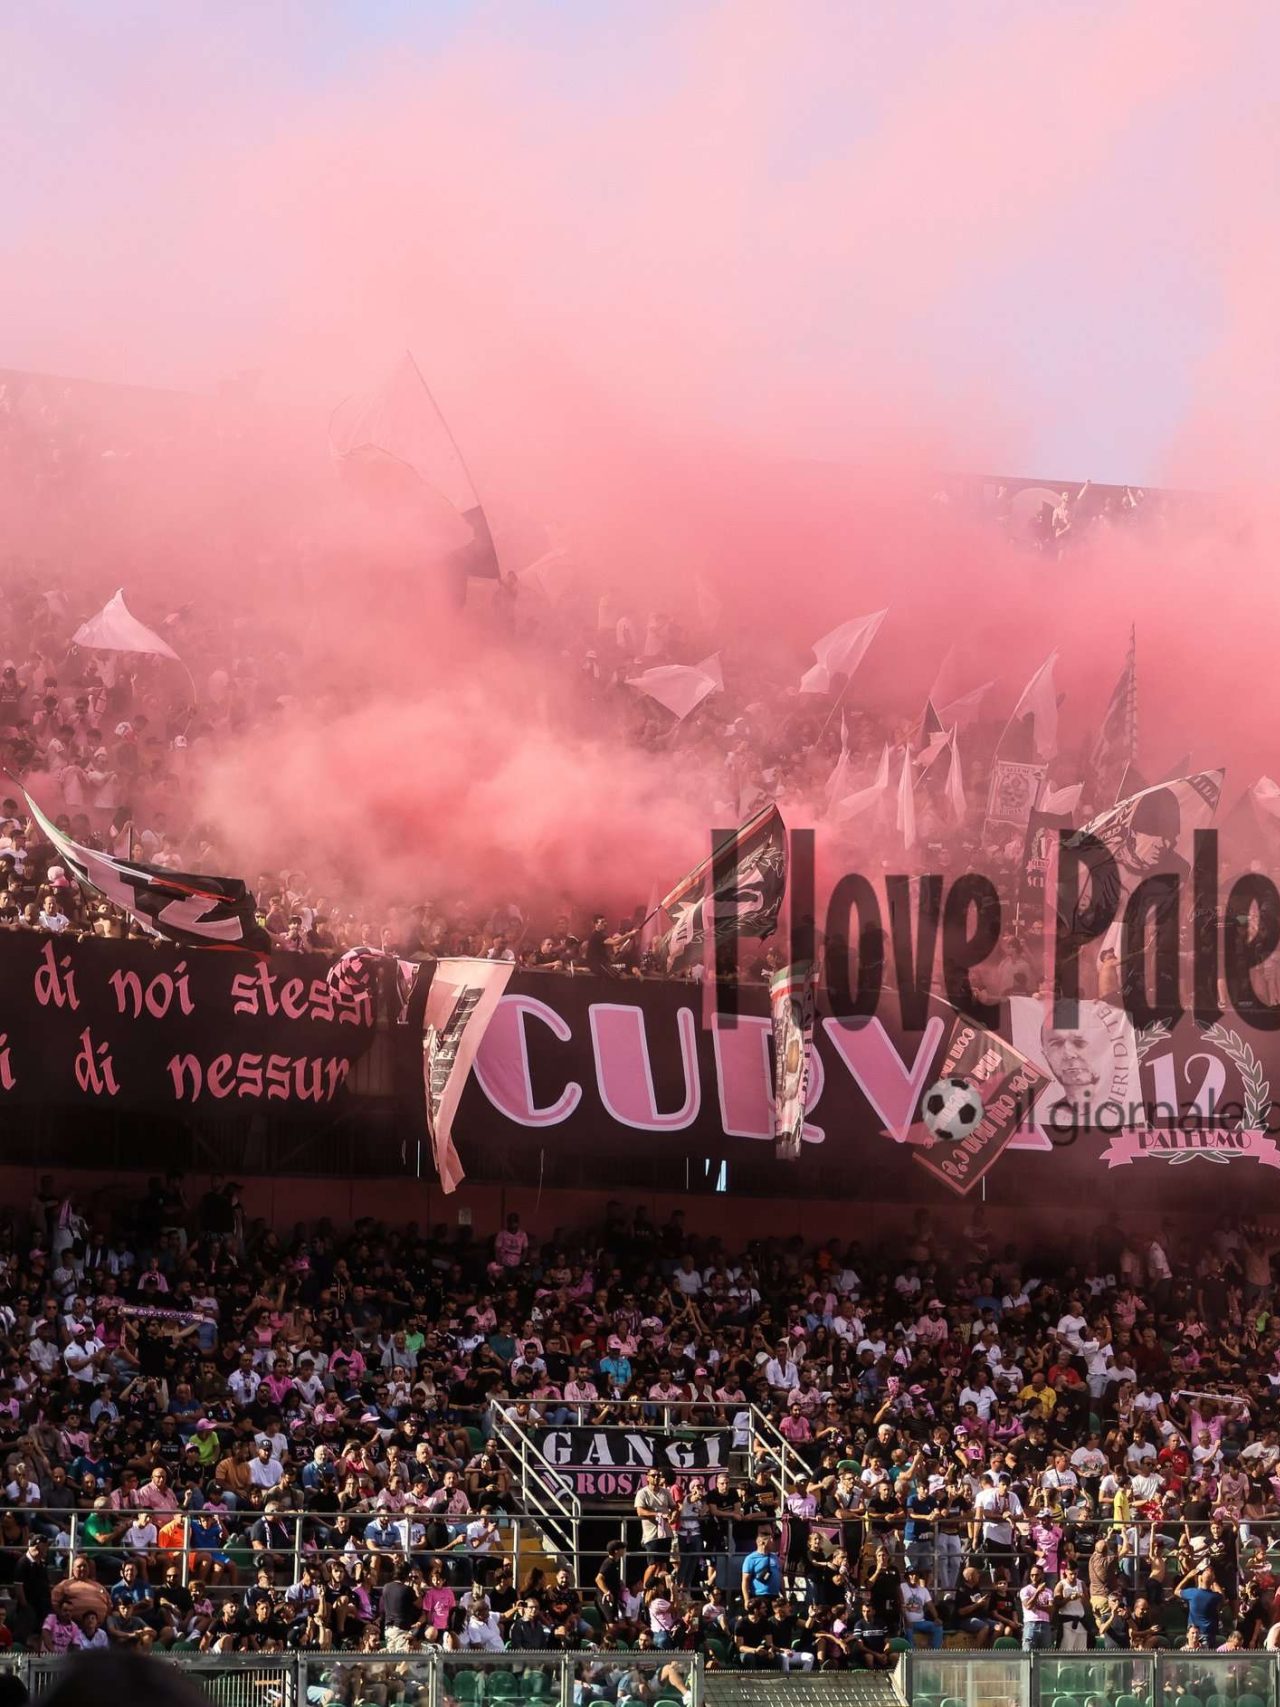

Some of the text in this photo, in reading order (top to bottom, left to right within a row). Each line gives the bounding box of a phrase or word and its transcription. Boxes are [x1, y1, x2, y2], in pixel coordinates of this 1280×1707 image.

[34, 939, 80, 1011] di
[108, 961, 196, 1019] noi
[1096, 1006, 1121, 1033] TE
[75, 1025, 120, 1096] di
[473, 994, 1053, 1152] CURV
[1110, 1036, 1129, 1059] DI
[1145, 1052, 1231, 1118] 12
[1138, 1130, 1252, 1149] PALERMO
[542, 1431, 723, 1469] GANGI
